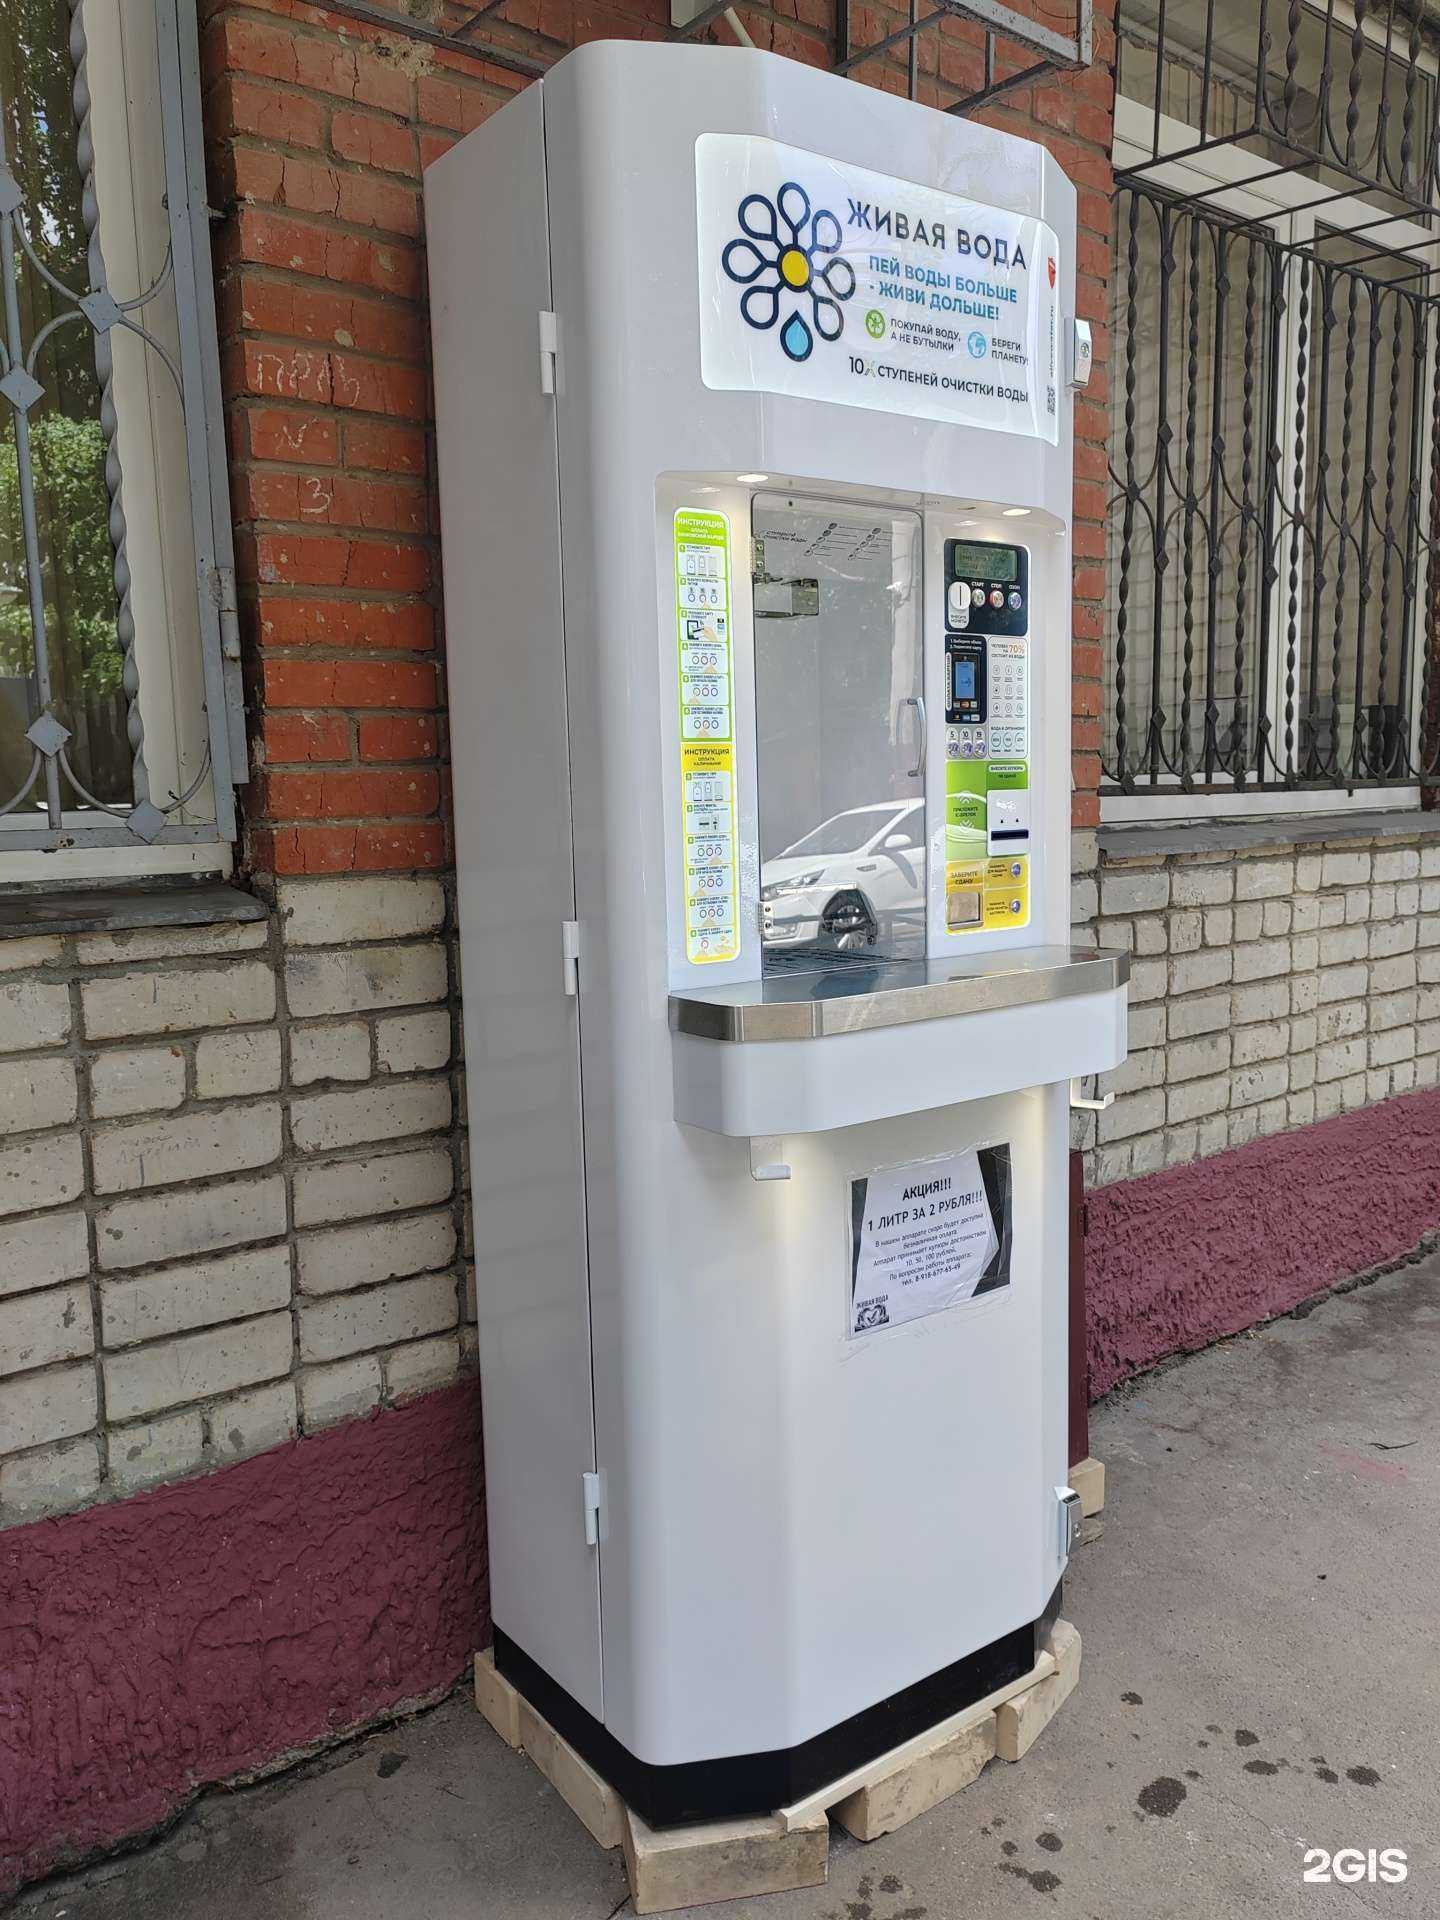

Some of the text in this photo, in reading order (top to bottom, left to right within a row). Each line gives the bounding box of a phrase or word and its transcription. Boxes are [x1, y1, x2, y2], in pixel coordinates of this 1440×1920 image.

[847, 198, 1027, 270] ЖИВАЯ ВОДА
[869, 255, 1017, 303] ПЕЙ ВОДЫ БОЛЬШЕ
[879, 281, 926, 306] ЖИВИ
[929, 293, 1000, 321] ДОЛЬШЕ!
[890, 318, 961, 342] ПОКУПАЙ ВОДУ,
[890, 333, 954, 352] А НЕ БУТЫЛКИ
[992, 337, 1021, 351] БЕРЕГИ
[877, 365, 938, 387] СТУПЕНЕЙ
[941, 377, 994, 396] ОЧИСТКИ
[997, 386, 1028, 403] ВОДЫ
[1008, 644, 1024, 654] 70%
[684, 748, 729, 756] ИНСТРУКЦИЯ
[902, 1177, 951, 1201] АКЦИЯ!!!
[868, 1190, 983, 1231] 1 ЛИТР ЗА 2 РУБЛЯ!!!
[875, 1240, 880, 1248] В
[901, 1230, 927, 1243] аппарате
